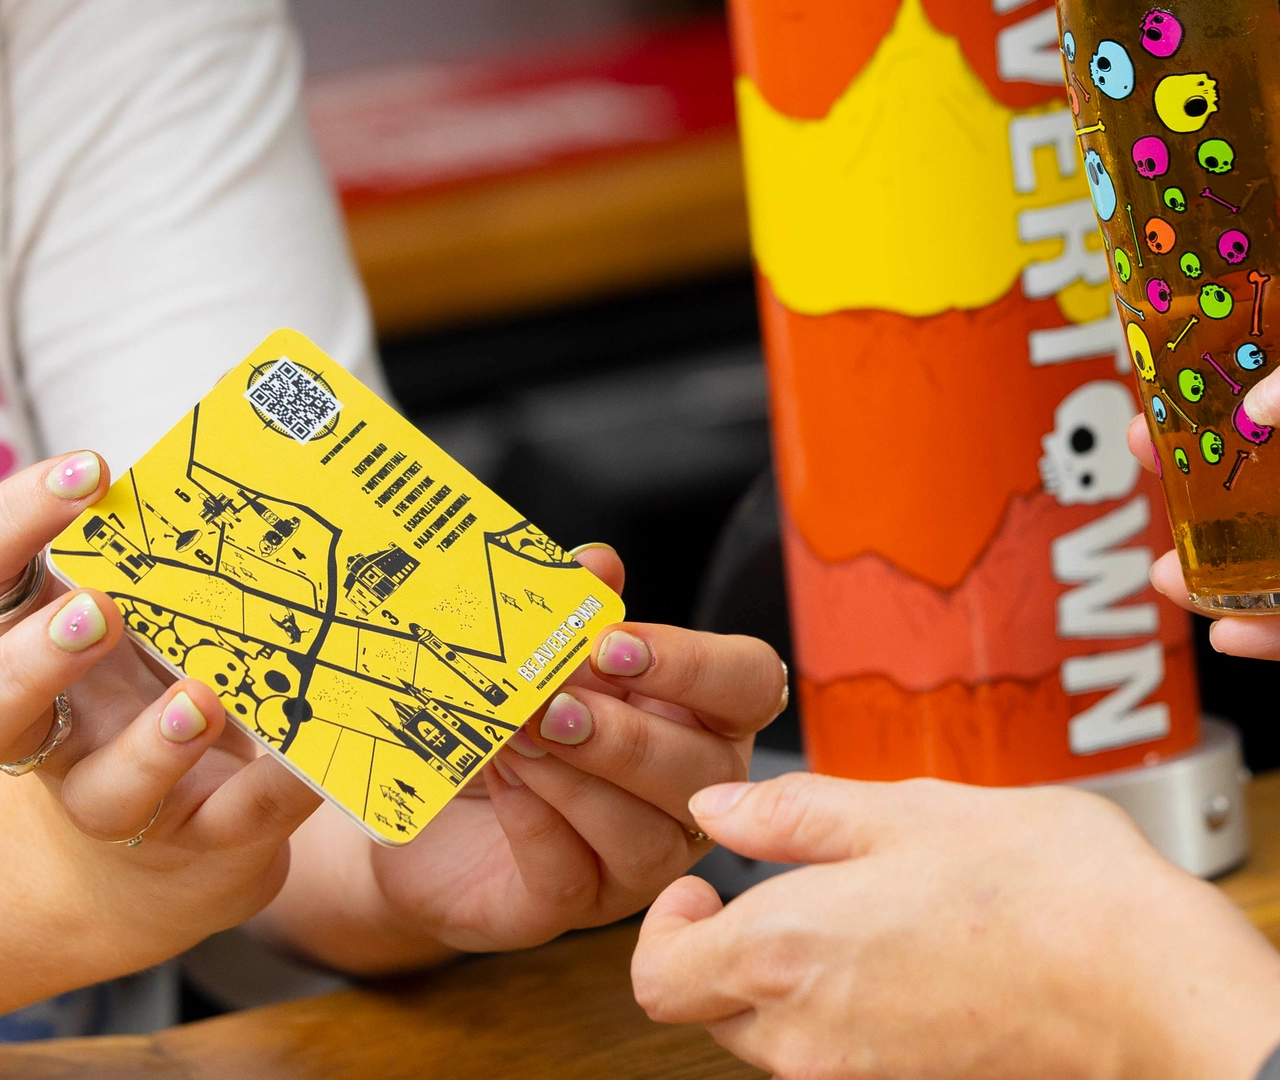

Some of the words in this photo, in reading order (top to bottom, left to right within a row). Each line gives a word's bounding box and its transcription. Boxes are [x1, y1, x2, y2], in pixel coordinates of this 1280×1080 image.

[353, 454, 375, 475] OXFORD
[370, 442, 387, 459] ROAD
[389, 451, 407, 466] HALL
[364, 460, 395, 490] WHITWORTH
[374, 500, 383, 508] 3
[401, 460, 422, 480] STREET
[174, 487, 191, 503] 5
[361, 486, 370, 494] 2
[394, 500, 409, 513] THE
[403, 487, 422, 504] VIMTO
[417, 475, 435, 492] PARK
[429, 484, 452, 505] GARDEN
[107, 512, 126, 529] 7
[406, 501, 435, 528] SACKVILLE
[428, 513, 449, 533] TURING
[403, 523, 412, 532] 5
[436, 544, 444, 552] 7
[440, 529, 460, 548] CIRCUS
[454, 512, 477, 533] TAVERN
[413, 541, 422, 549] 6
[416, 528, 434, 546] ALAN
[194, 548, 214, 566] 6
[292, 547, 307, 560] 4
[381, 609, 400, 626] 3
[517, 594, 604, 683] BEAVERTOWN
[502, 677, 519, 692] 1
[484, 725, 504, 742] 2
